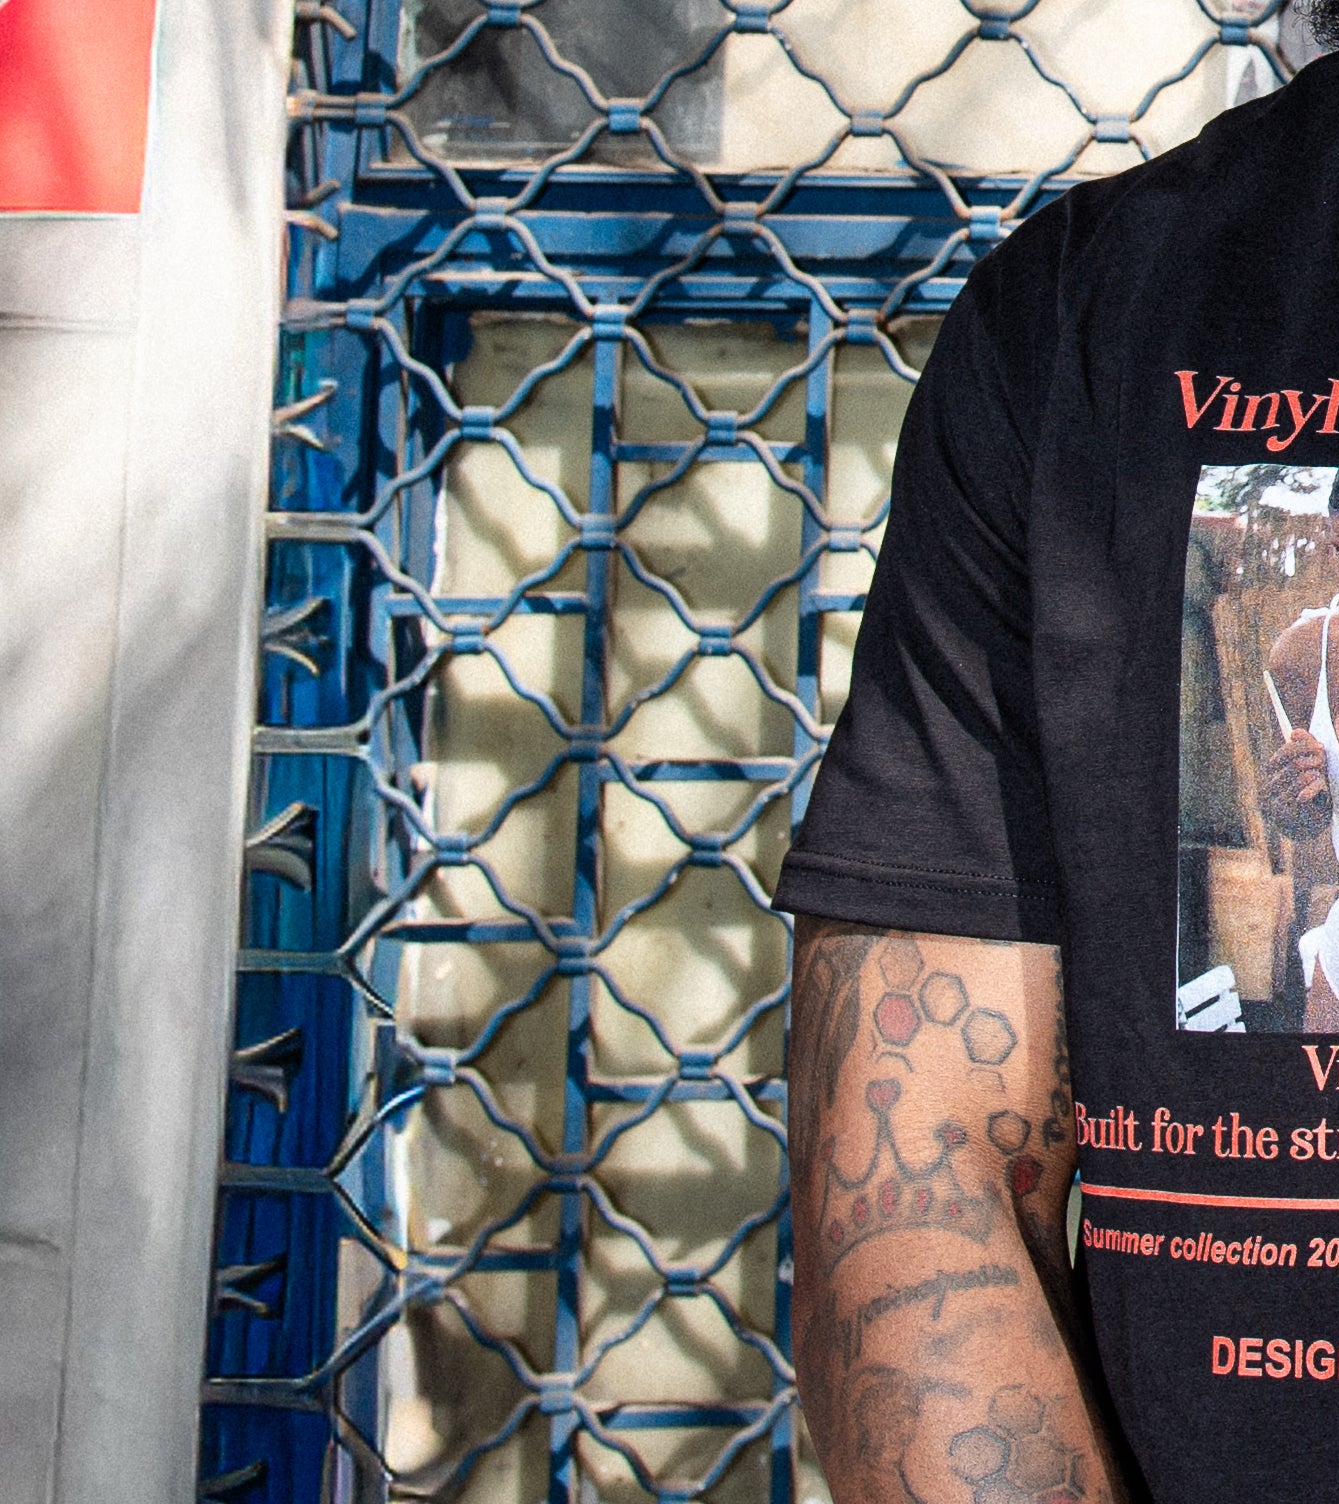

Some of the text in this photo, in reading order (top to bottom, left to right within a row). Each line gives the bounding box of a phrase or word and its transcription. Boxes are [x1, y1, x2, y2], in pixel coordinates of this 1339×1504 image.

[1075, 1101, 1140, 1152] Built
[1152, 1108, 1204, 1156] for
[1213, 1113, 1279, 1160] the
[1082, 1218, 1165, 1256] Summer
[1170, 1232, 1298, 1267] collection
